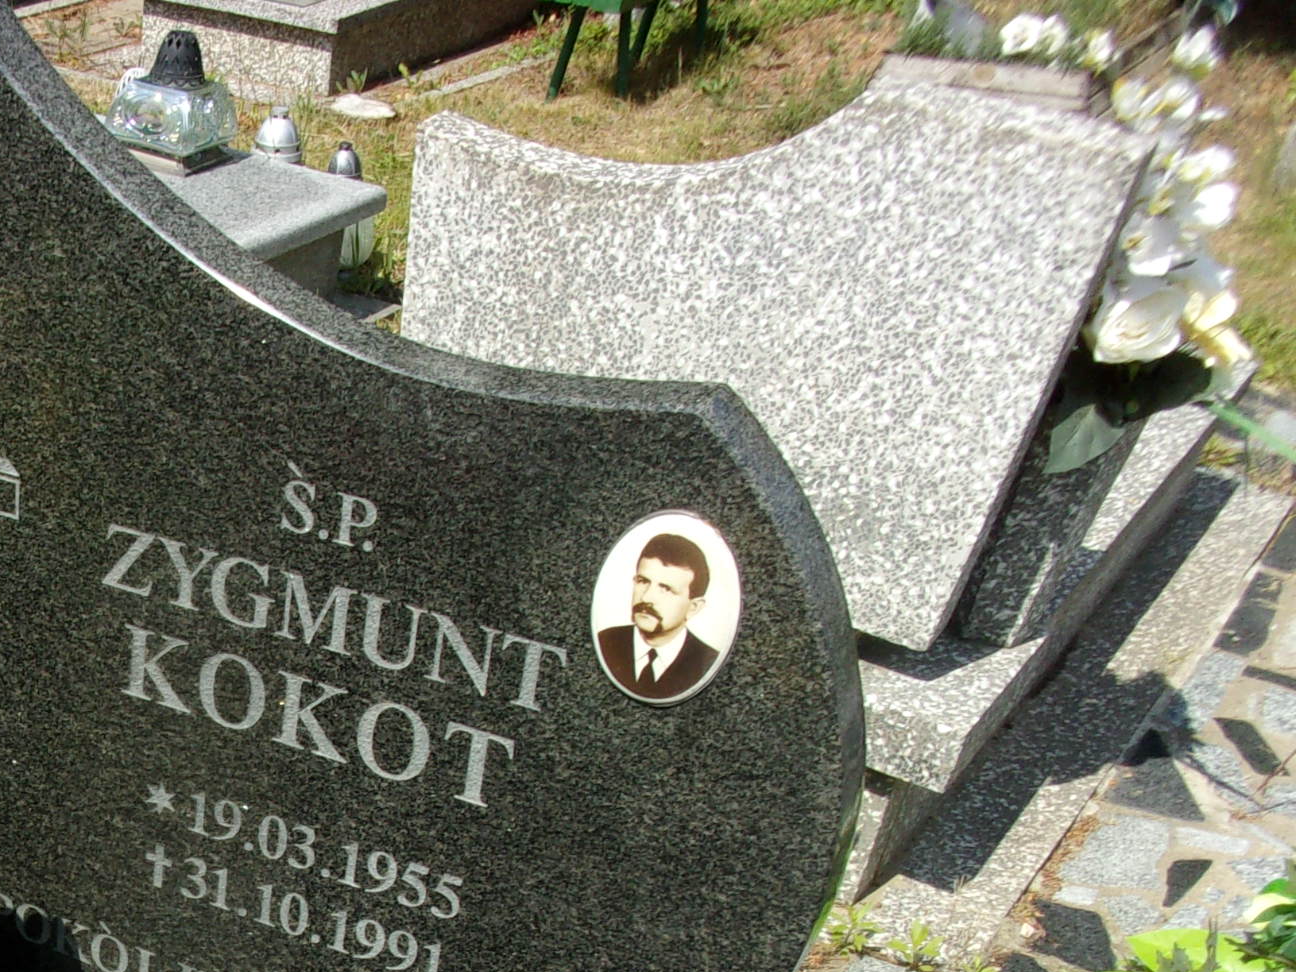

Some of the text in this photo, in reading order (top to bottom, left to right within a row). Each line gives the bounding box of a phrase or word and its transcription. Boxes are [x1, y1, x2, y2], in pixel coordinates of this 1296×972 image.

[102, 523, 568, 712] ZYGMUNT
[121, 623, 515, 808] KOKOT
[188, 792, 463, 918] 19.03.1955
